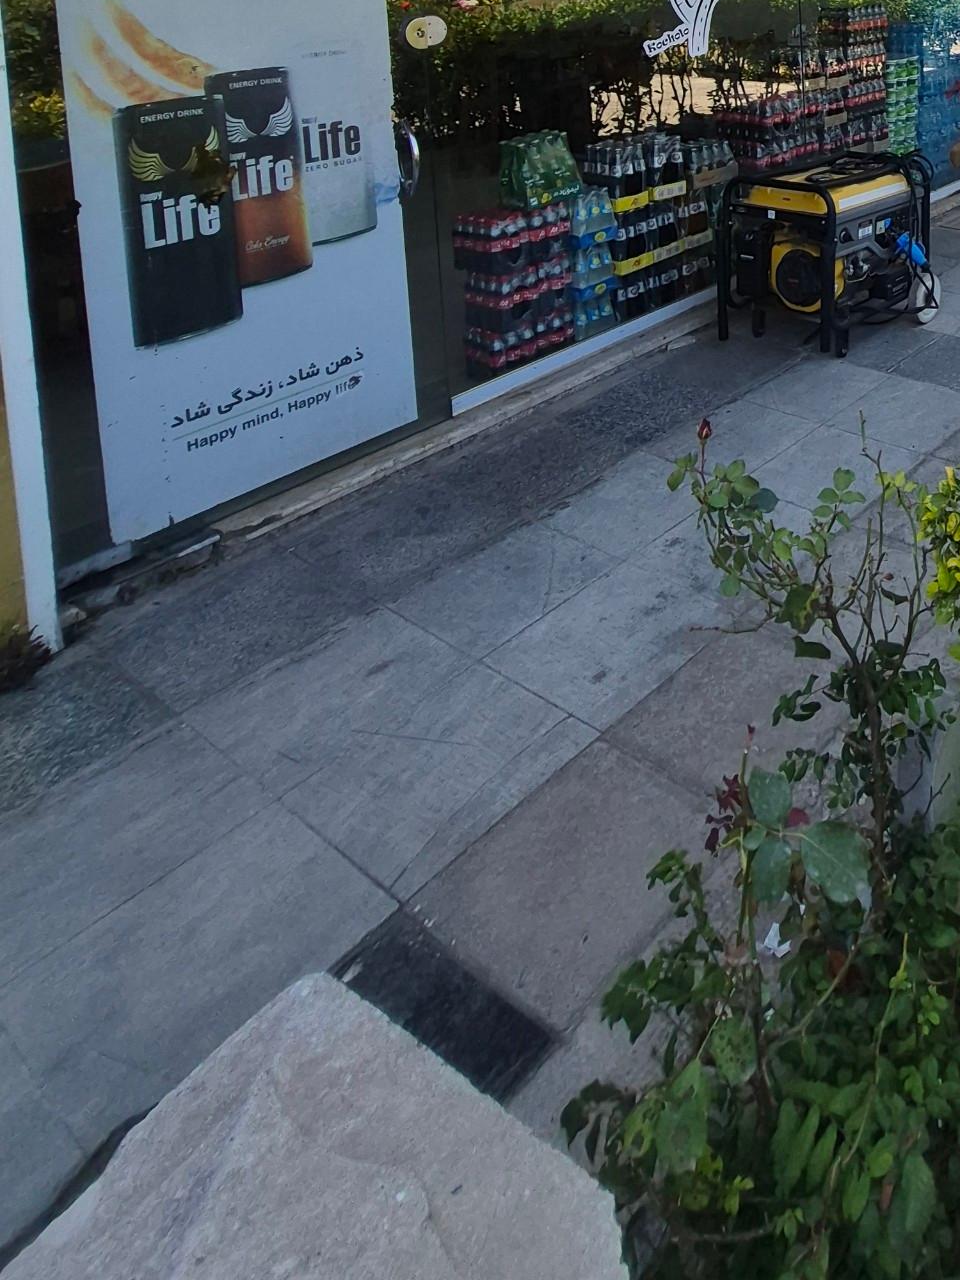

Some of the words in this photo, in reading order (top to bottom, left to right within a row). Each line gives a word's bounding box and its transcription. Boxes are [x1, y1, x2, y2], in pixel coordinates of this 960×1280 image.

[228, 79, 258, 90] ENERGY
[260, 77, 283, 86] DRINK
[140, 112, 176, 124] ENERGY
[177, 107, 205, 118] DRINK
[302, 120, 361, 164] Life
[229, 153, 294, 202] Life
[140, 194, 221, 250] Life
[325, 346, 364, 376] ذهن
[171, 400, 211, 429] شاد
[217, 380, 274, 415] زندگی
[186, 425, 238, 453] Happy
[242, 407, 285, 432] mind,
[287, 389, 332, 414] Happy
